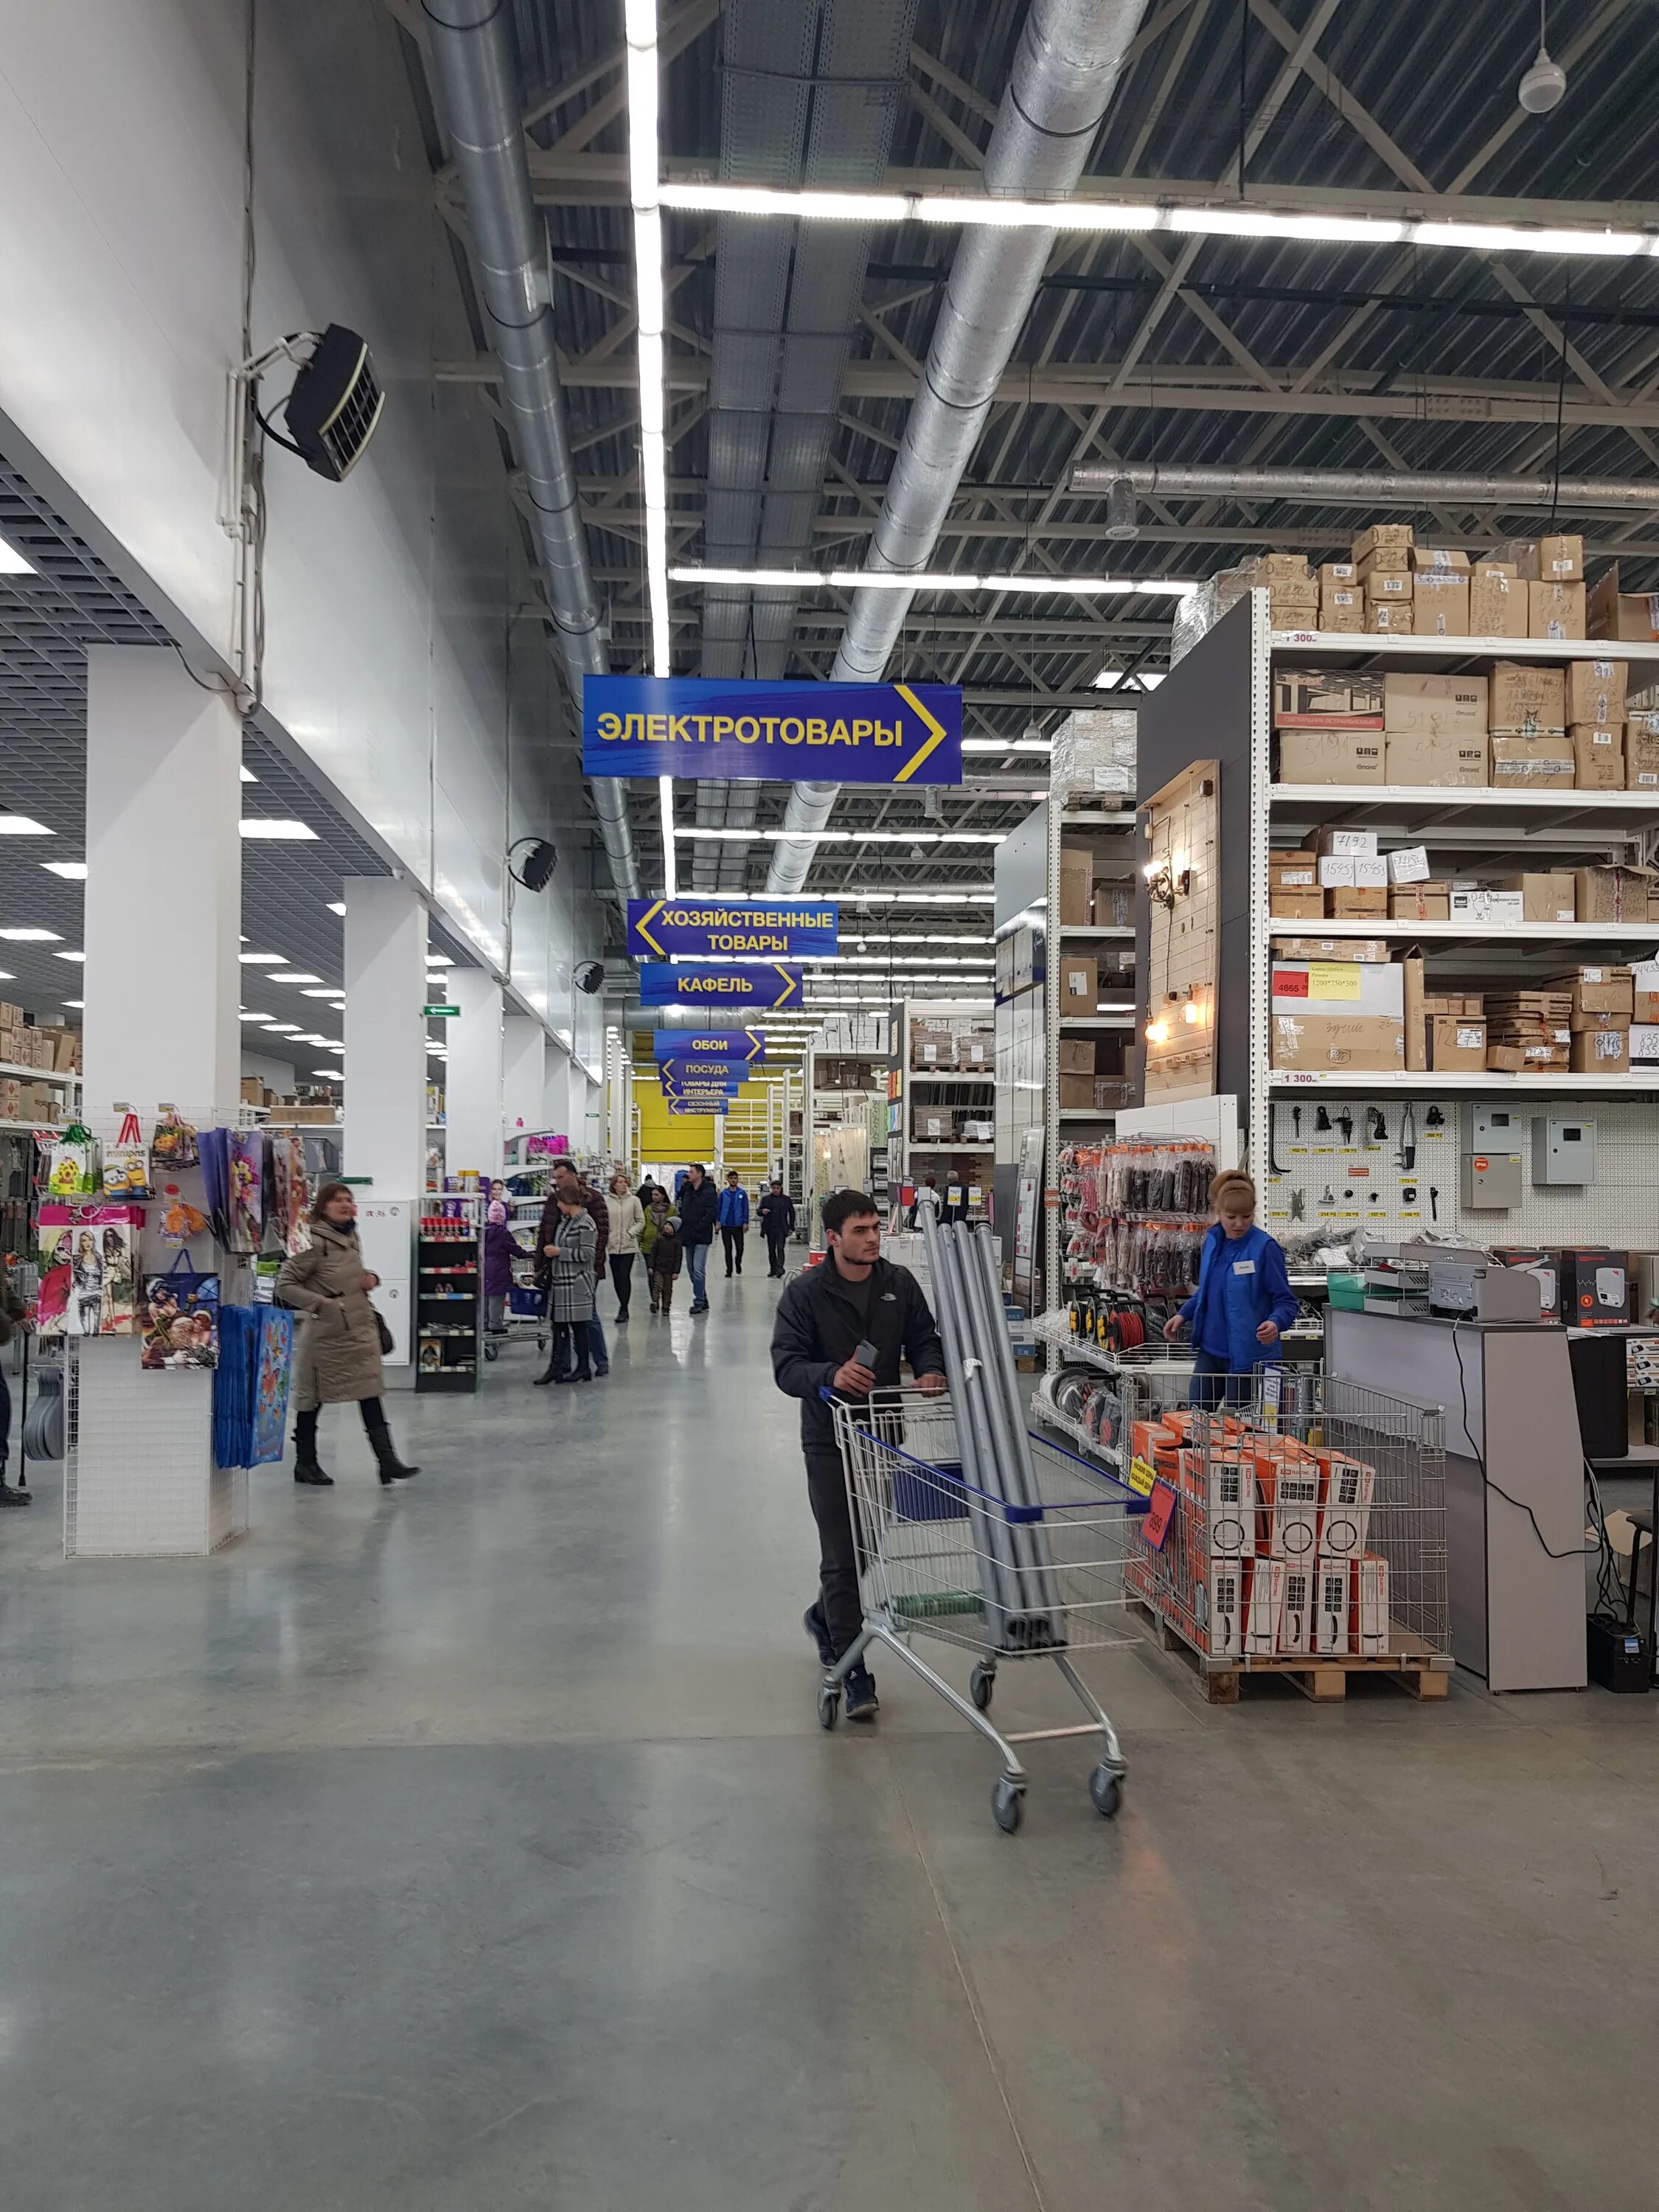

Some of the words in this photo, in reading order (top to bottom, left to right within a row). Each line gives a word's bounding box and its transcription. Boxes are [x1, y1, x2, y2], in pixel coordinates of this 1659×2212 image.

[597, 712, 903, 748] ЭЛЕКТРОТОВАРЫ
[1337, 835, 1368, 849] 7192
[1358, 862, 1385, 877] 15453
[661, 908, 834, 929] ХОЗЯЙСТВЕННЫЕ
[708, 934, 788, 952] ТОВАРЫ
[677, 976, 754, 993] КАФЕЛЬ
[1279, 984, 1299, 992] 4665
[692, 1040, 728, 1051] ОБОИ
[685, 1064, 729, 1076] ПОСУДА
[683, 1088, 725, 1096] ИНТЕРЬЕРА
[106, 1149, 146, 1158] minions
[1149, 1512, 1163, 1534] 899
